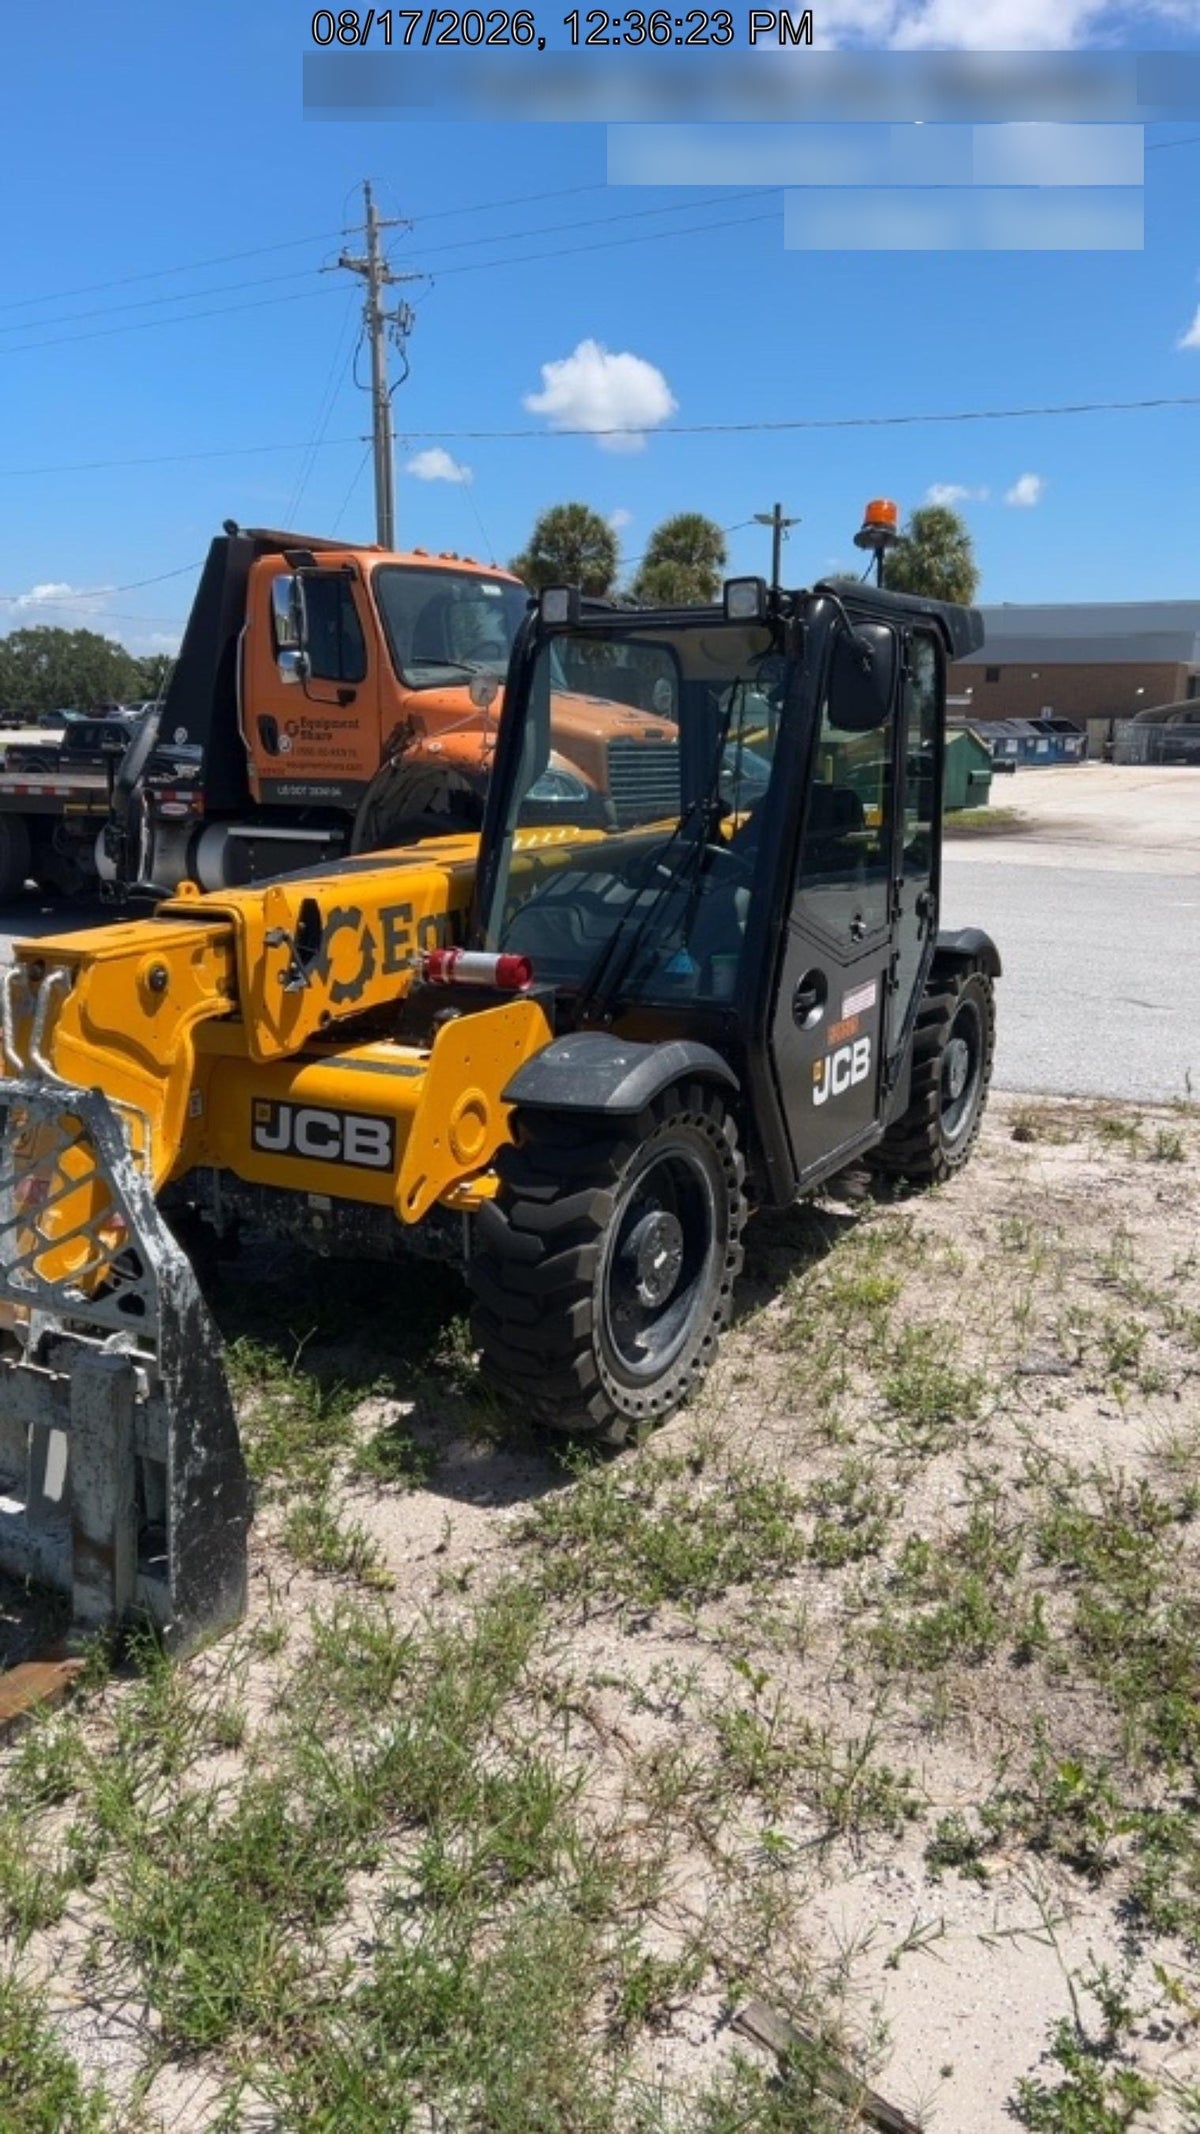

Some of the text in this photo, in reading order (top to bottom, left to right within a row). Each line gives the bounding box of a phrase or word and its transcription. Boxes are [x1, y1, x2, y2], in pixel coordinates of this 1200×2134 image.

[300, 716, 359, 731] Equipment
[300, 730, 333, 740] Share
[813, 1035, 871, 1106] JCB
[256, 1104, 392, 1166] JCB
